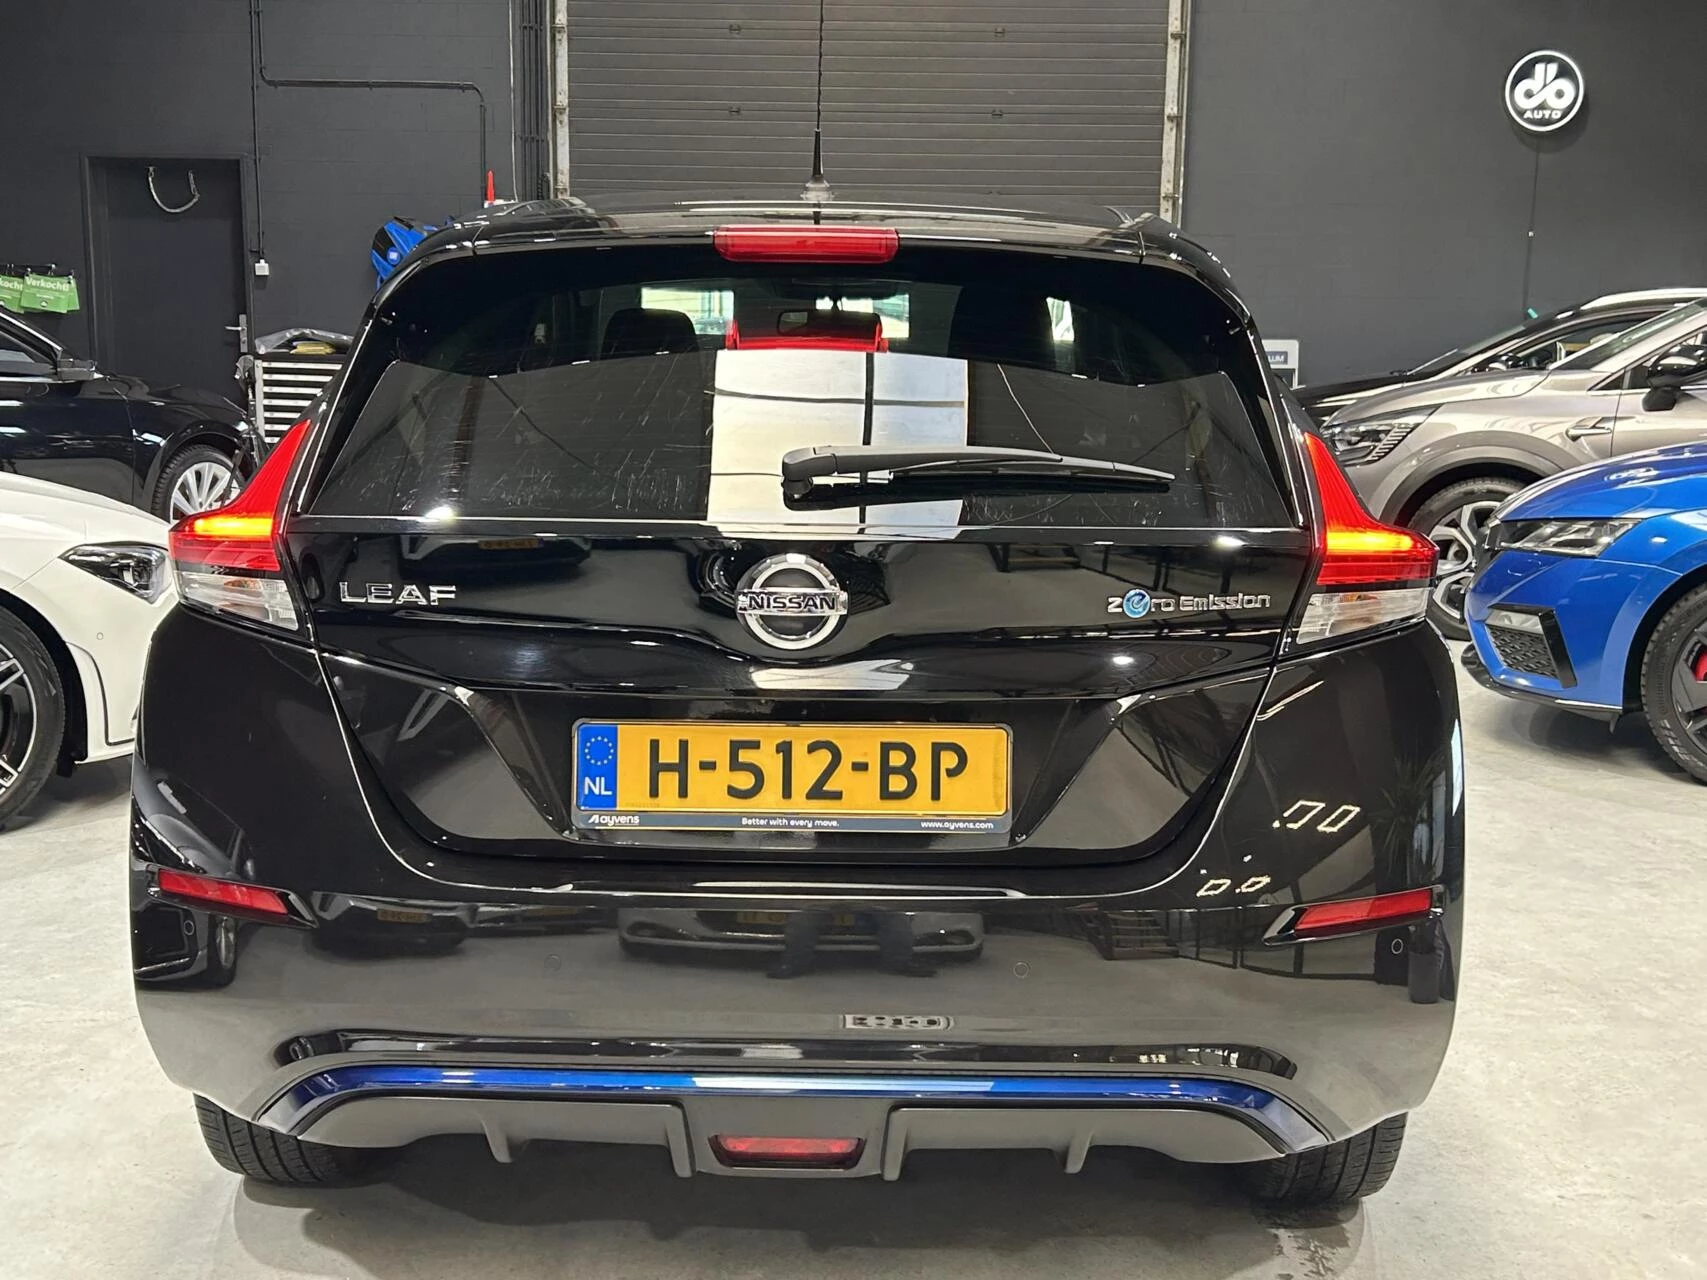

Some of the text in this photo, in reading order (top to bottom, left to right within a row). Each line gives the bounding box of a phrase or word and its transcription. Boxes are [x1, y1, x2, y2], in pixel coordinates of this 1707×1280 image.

[1523, 109, 1562, 119] AUTO
[339, 581, 456, 606] LEAF
[748, 594, 836, 610] NISSAN
[1179, 592, 1271, 611] Emission
[649, 738, 969, 802] H-512-BP
[583, 776, 613, 796] NL
[599, 815, 640, 827] ayvens
[741, 816, 840, 828] Better with every move.
